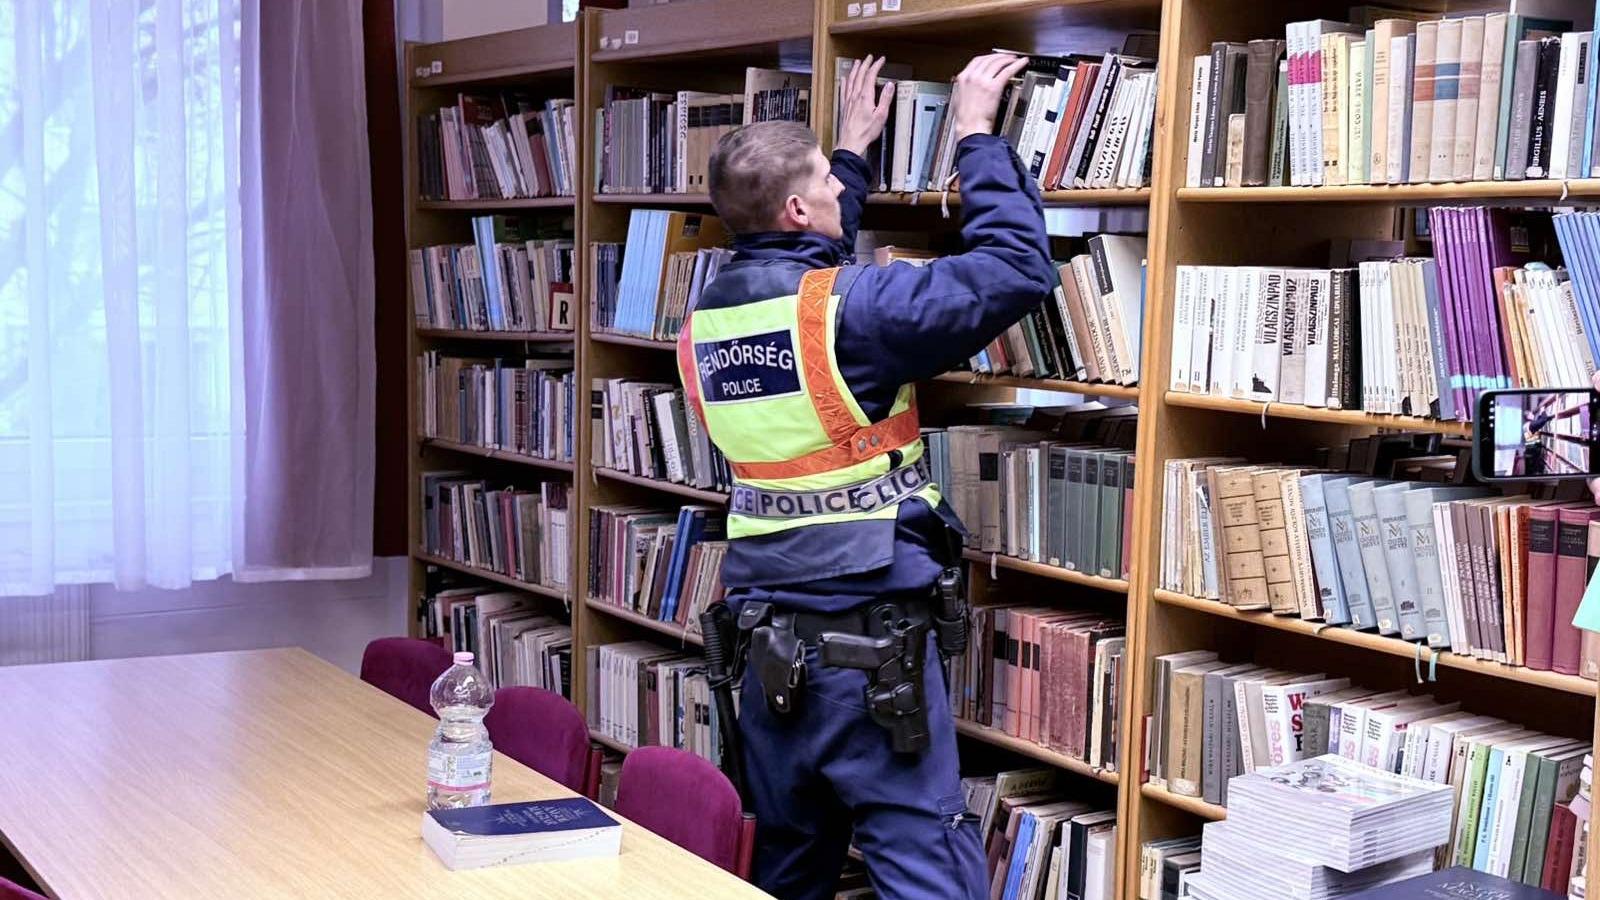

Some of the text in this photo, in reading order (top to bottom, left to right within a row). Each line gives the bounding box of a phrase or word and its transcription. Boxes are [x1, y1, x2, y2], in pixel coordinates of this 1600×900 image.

[1532, 126, 1543, 167] ERGILIUS
[560, 300, 568, 324] R
[698, 340, 794, 382] RENDŐRSÉG
[722, 378, 763, 396] POLICE
[734, 488, 753, 512] CE
[761, 488, 860, 515] POLICE
